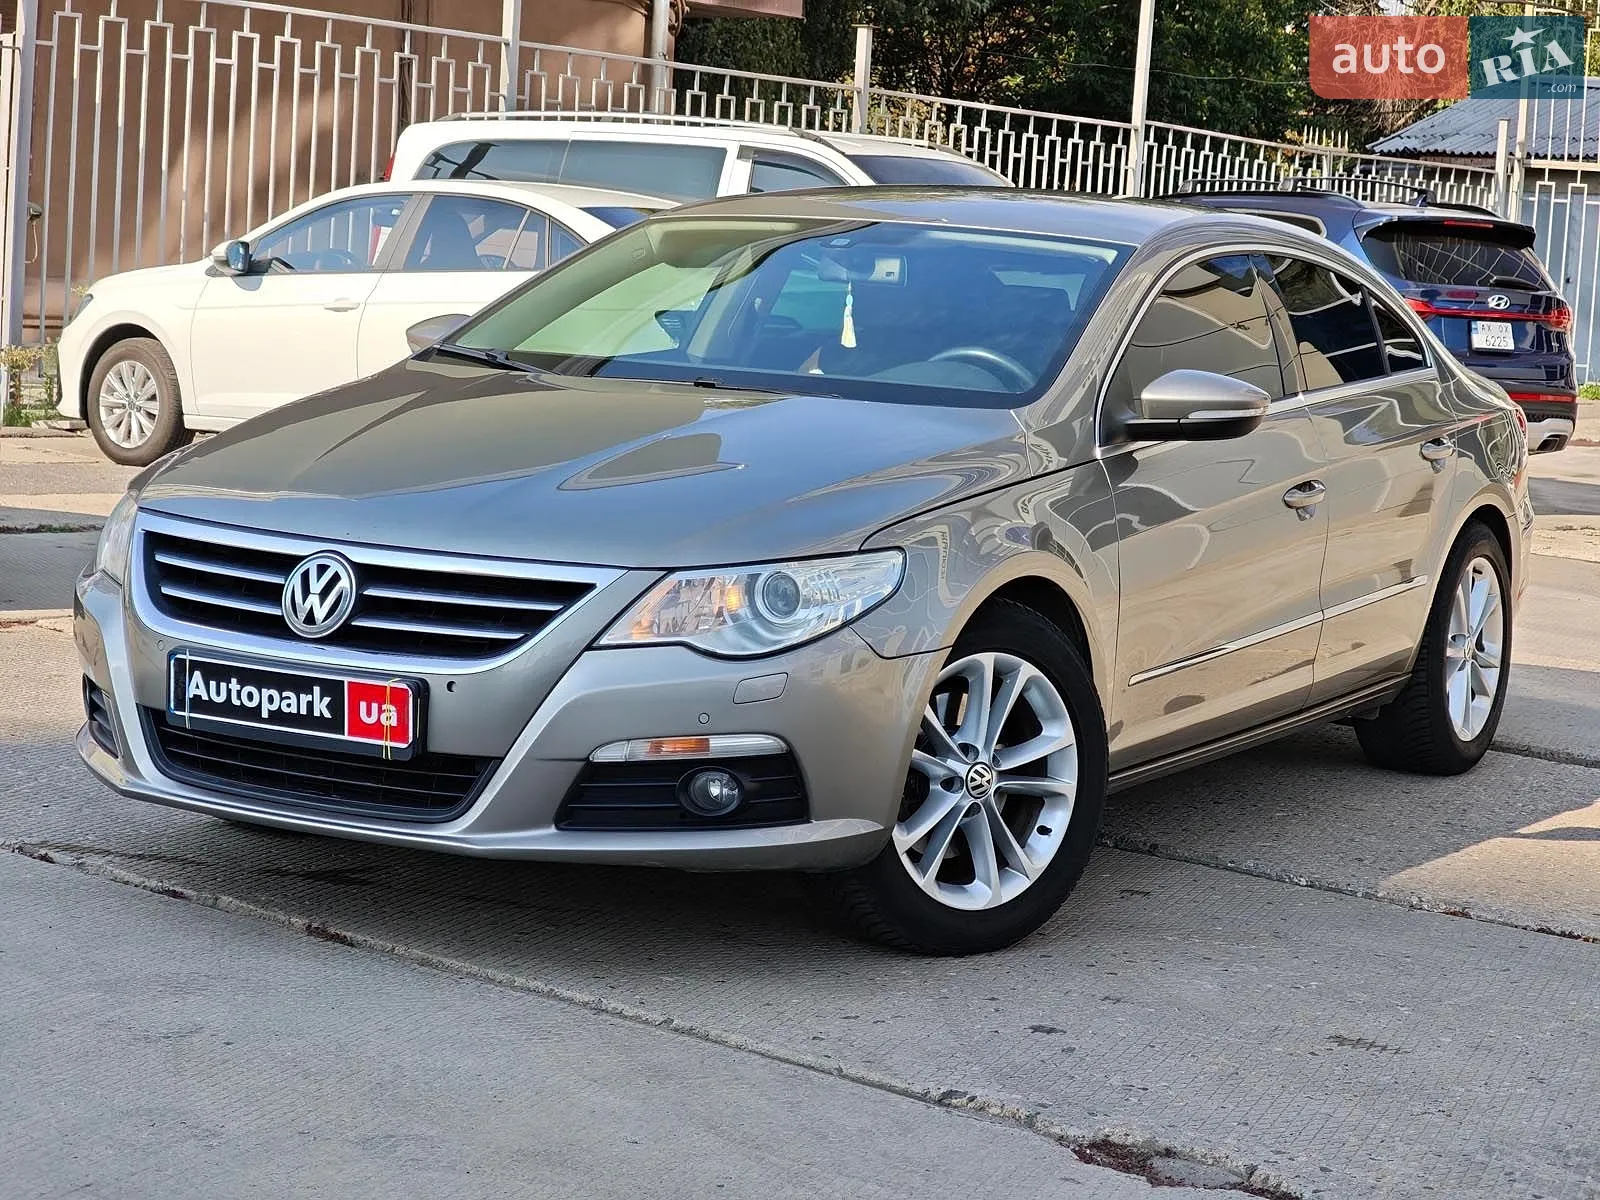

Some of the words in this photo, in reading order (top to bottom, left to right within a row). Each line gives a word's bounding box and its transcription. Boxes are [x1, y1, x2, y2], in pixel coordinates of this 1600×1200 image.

[1485, 335, 1509, 347] 6225
[284, 555, 353, 636] VW
[188, 670, 332, 719] Autopark
[359, 701, 398, 727] ua
